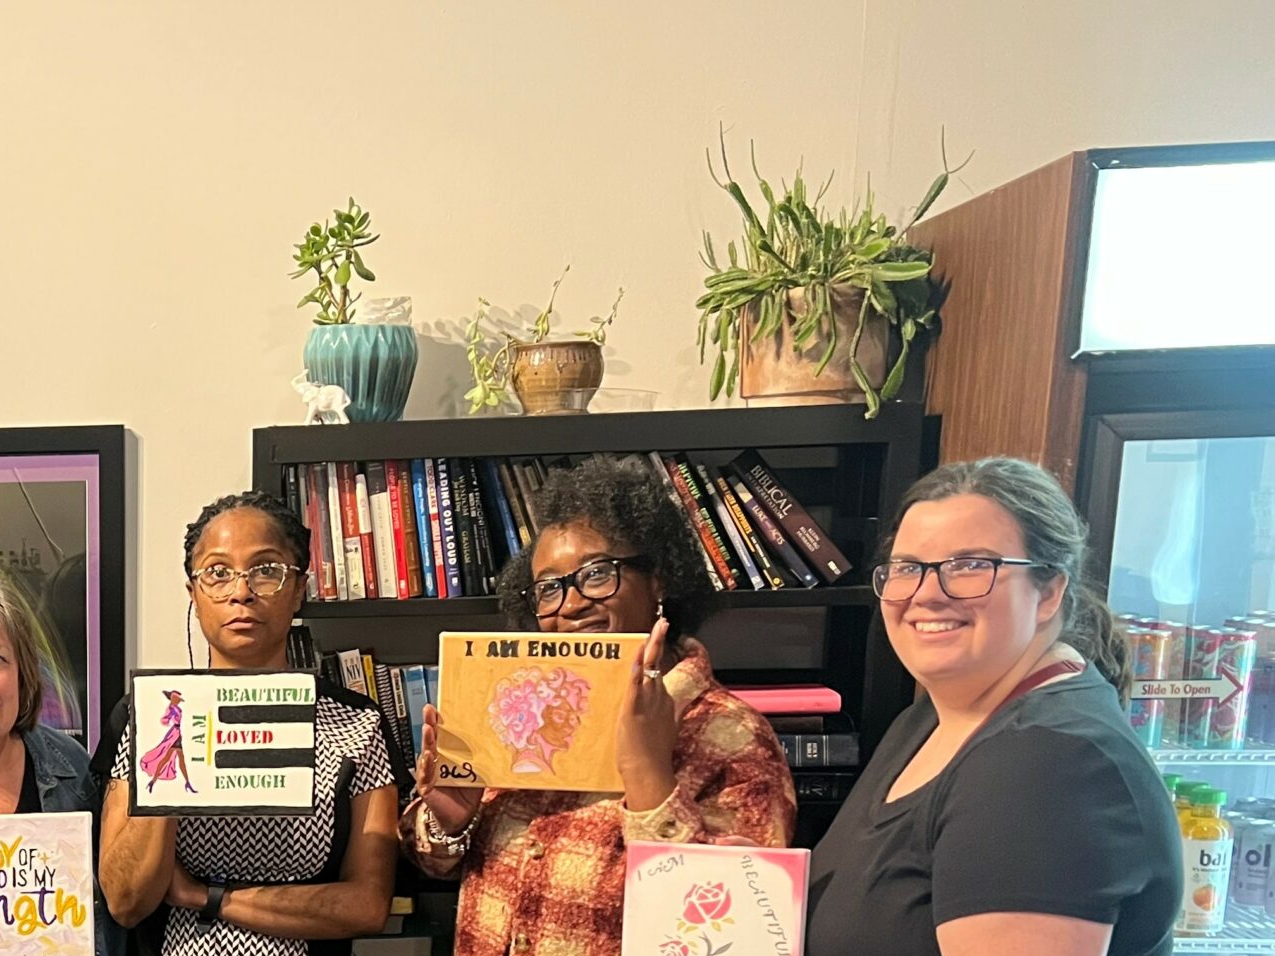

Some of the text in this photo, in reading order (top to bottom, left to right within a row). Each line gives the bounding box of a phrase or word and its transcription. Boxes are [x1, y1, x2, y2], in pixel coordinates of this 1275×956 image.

[458, 474, 469, 516] WISDOM
[750, 465, 793, 516] BIBLICAL
[437, 458, 457, 565] LEADING OUT LOUD
[733, 503, 752, 535] DISAPPOINTS
[752, 504, 785, 545] LUKE ACTS
[461, 530, 471, 564] GRAHAM
[465, 639, 621, 660] I AM ENOUGH
[347, 664, 361, 680] NIV
[216, 688, 315, 703] BEAUTIFUL
[1141, 684, 1212, 697] Slide To Open
[191, 715, 207, 744] AM
[216, 730, 274, 744] LOVED
[215, 775, 286, 789] ENOUGH
[18, 848, 38, 871] OF
[12, 868, 27, 888] IS
[34, 866, 56, 888] MY
